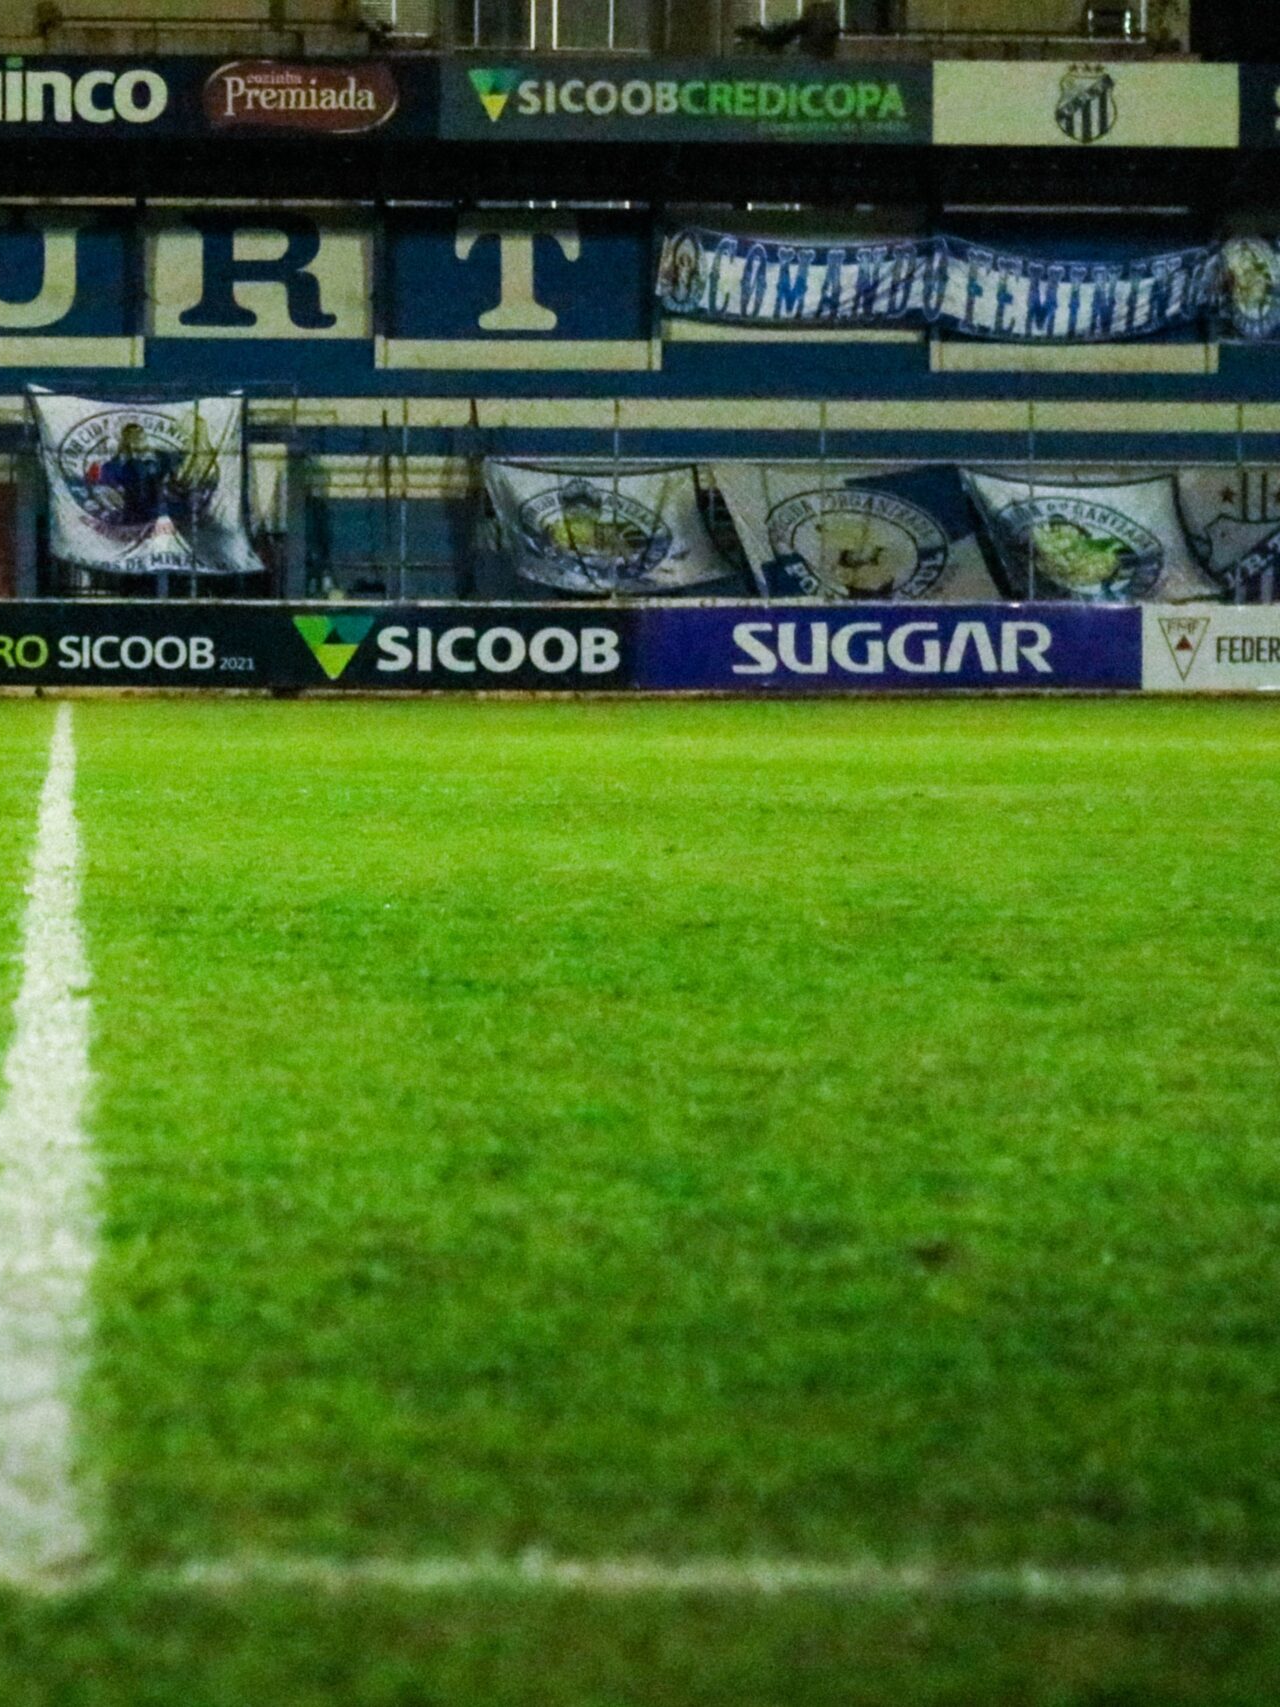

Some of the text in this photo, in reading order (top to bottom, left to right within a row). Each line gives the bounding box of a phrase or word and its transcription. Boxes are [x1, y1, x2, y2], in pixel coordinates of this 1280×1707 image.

[223, 76, 376, 116] Premiada
[58, 635, 215, 670] SICOOB
[220, 656, 255, 671] 2021
[376, 626, 620, 673] SICOOB
[732, 622, 1053, 674] SUGGAR
